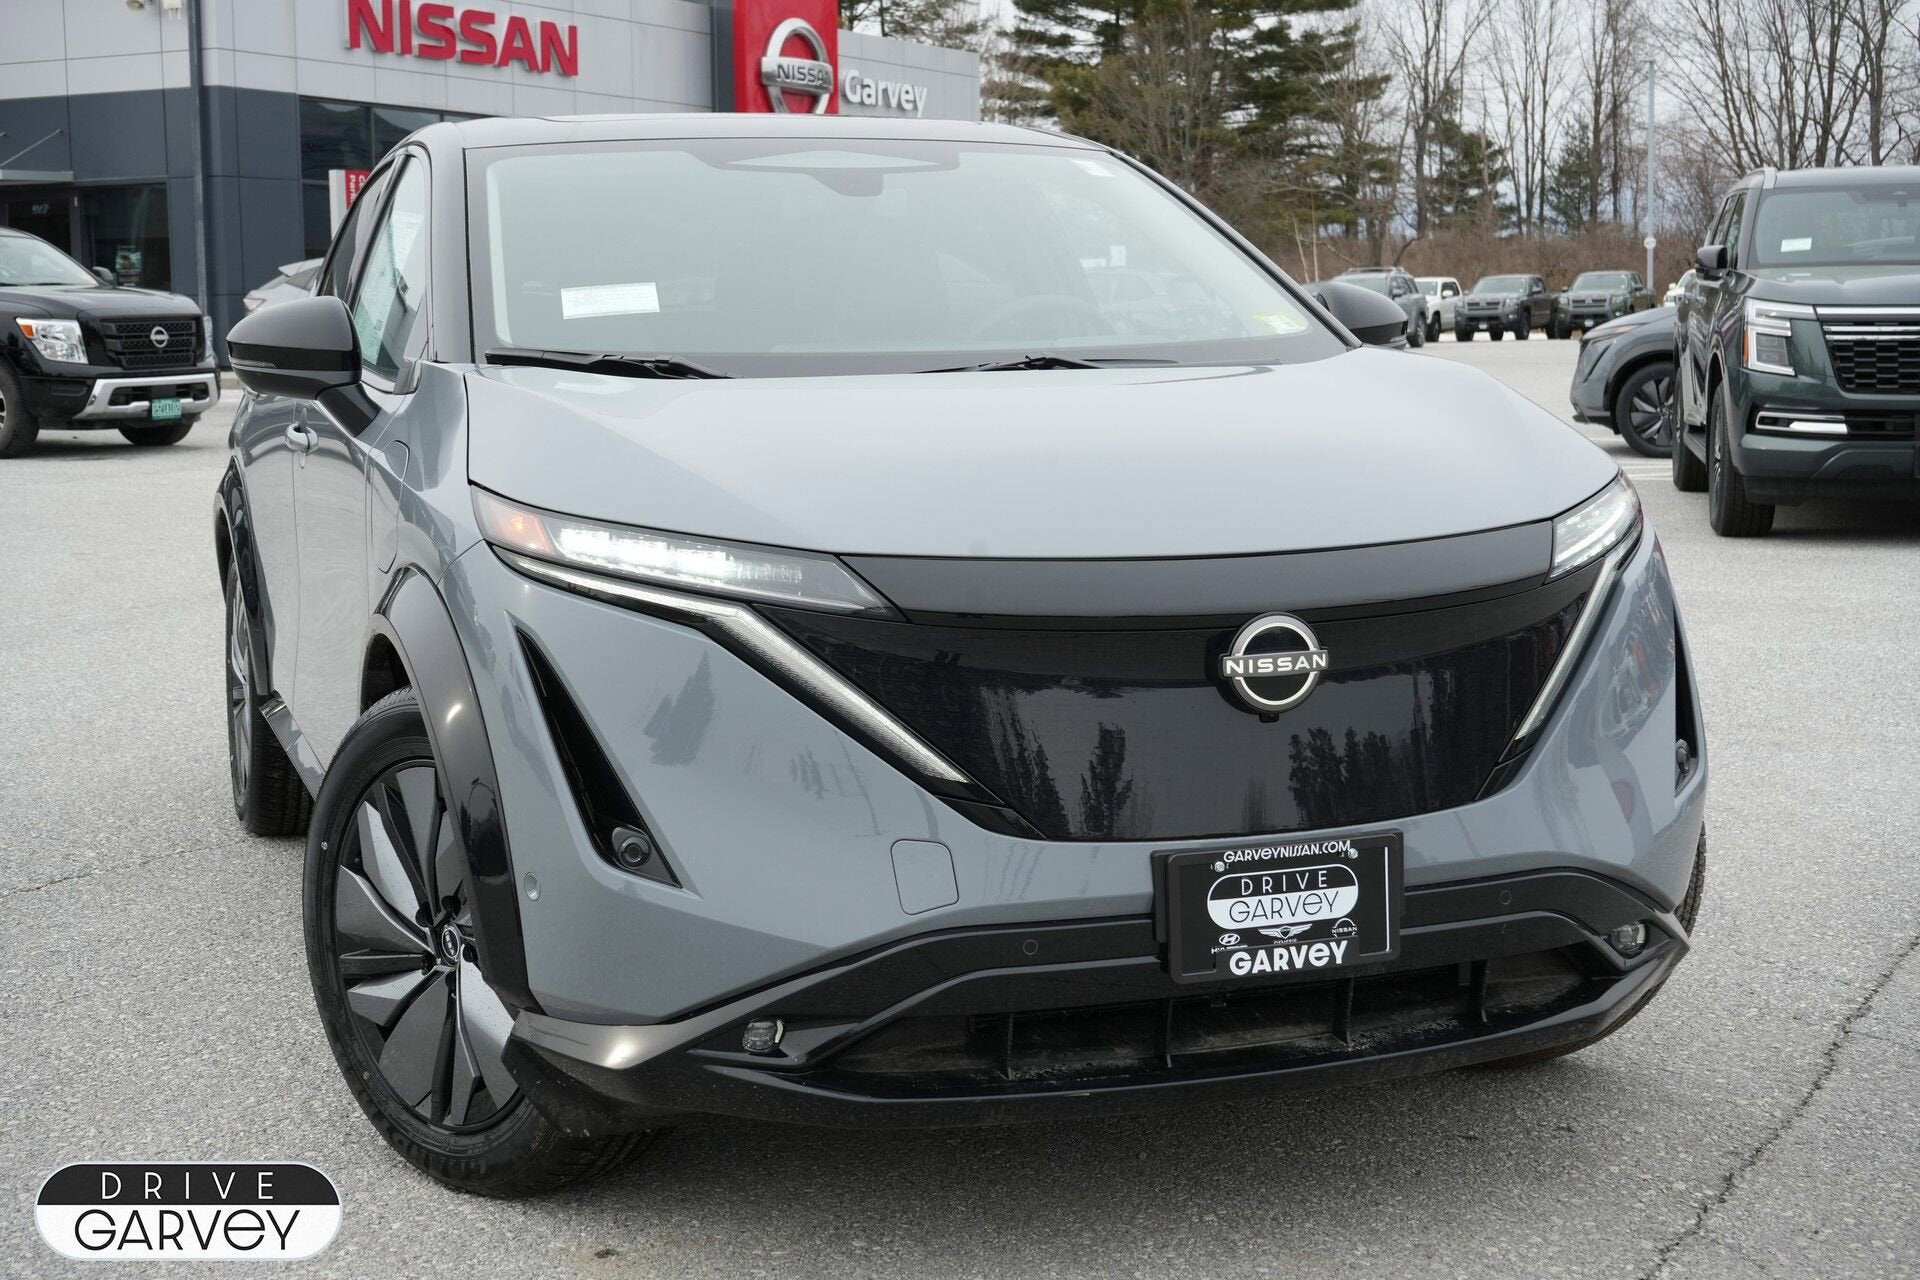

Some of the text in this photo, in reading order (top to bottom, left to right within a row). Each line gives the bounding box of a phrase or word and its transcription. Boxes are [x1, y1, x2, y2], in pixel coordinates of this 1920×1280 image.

[347, 0, 578, 76] NISSAN
[844, 68, 927, 118] Garvey
[1226, 653, 1326, 674] NISSAN
[1241, 870, 1328, 896] DRIVE
[1331, 926, 1358, 934] NISSAN
